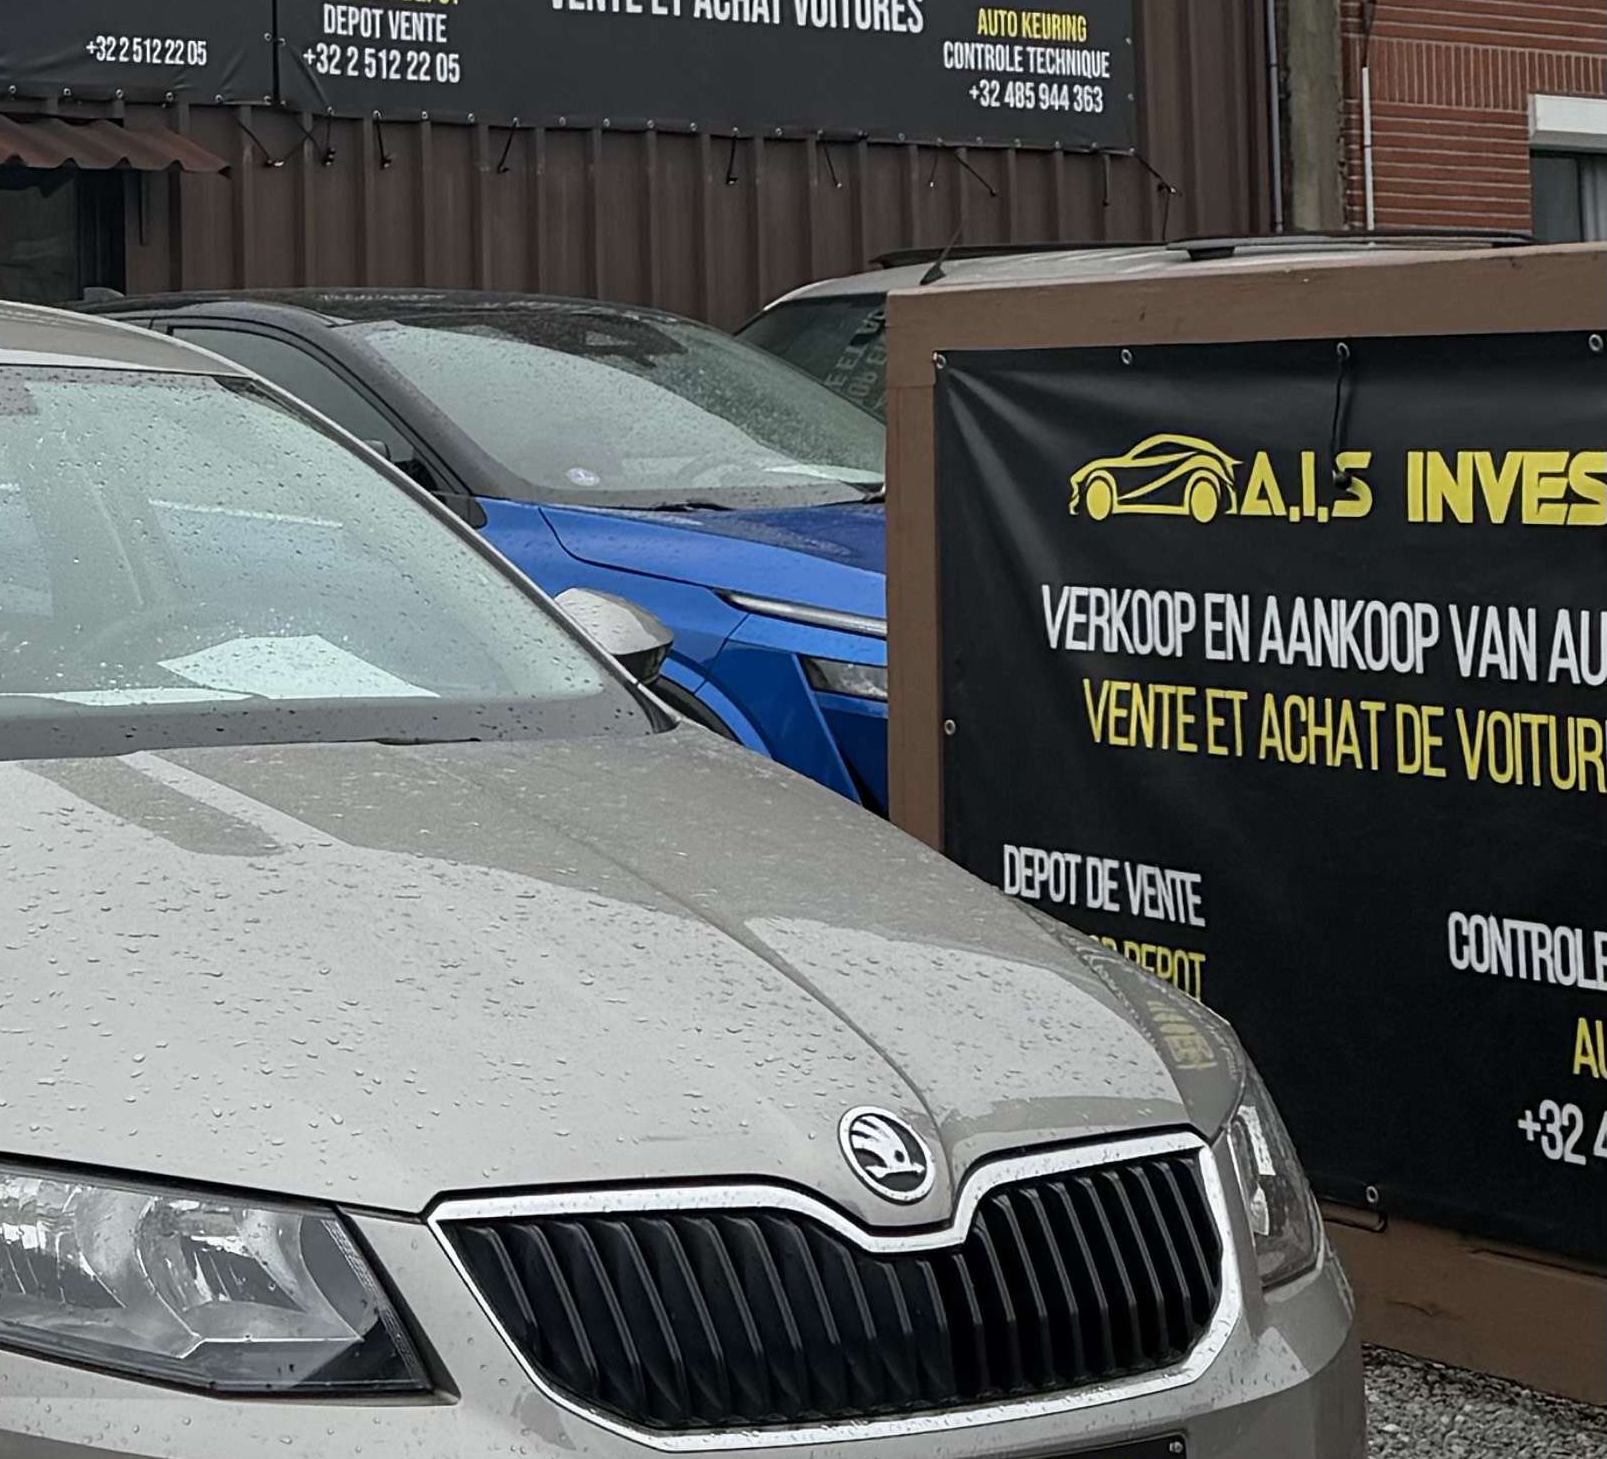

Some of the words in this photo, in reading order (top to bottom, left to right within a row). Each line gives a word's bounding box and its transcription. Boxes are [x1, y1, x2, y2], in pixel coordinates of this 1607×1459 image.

[323, 3, 384, 39] DEPOT
[388, 10, 447, 42] VENTE
[977, 7, 1017, 38] AUTO
[1021, 11, 1087, 42] KEURING
[86, 35, 116, 61] +32
[119, 36, 129, 62] 2
[133, 37, 162, 64] 512
[164, 39, 185, 65] 22
[187, 40, 207, 66] 05
[303, 42, 341, 75] +32
[346, 46, 359, 76] 2
[364, 47, 402, 79] 512
[406, 50, 431, 81] 22
[436, 52, 461, 83] 05
[943, 40, 1024, 73] CONTROLE
[1026, 46, 1110, 79] TECHNIQUE
[969, 79, 1000, 107] +32
[1004, 80, 1035, 109] 485
[1038, 82, 1069, 111] 944
[1073, 84, 1103, 113] 363
[1239, 451, 1373, 523] A.I.S
[1041, 584, 1196, 657] VERKOOP
[1205, 592, 1250, 663] EN
[1258, 596, 1440, 674] AANKOOP
[1448, 603, 1537, 682] VAN
[1083, 678, 1198, 753] VENTE
[1205, 688, 1249, 757] ET
[1258, 692, 1387, 771] ACHAT
[1396, 703, 1447, 778] DE
[1455, 707, 1607, 793] VOITUR
[1003, 844, 1082, 905] DEPOT
[1086, 856, 1120, 912] DE
[1124, 861, 1206, 927] VENTE
[1448, 911, 1607, 991] CONTROLE
[1518, 1099, 1587, 1166] +32
